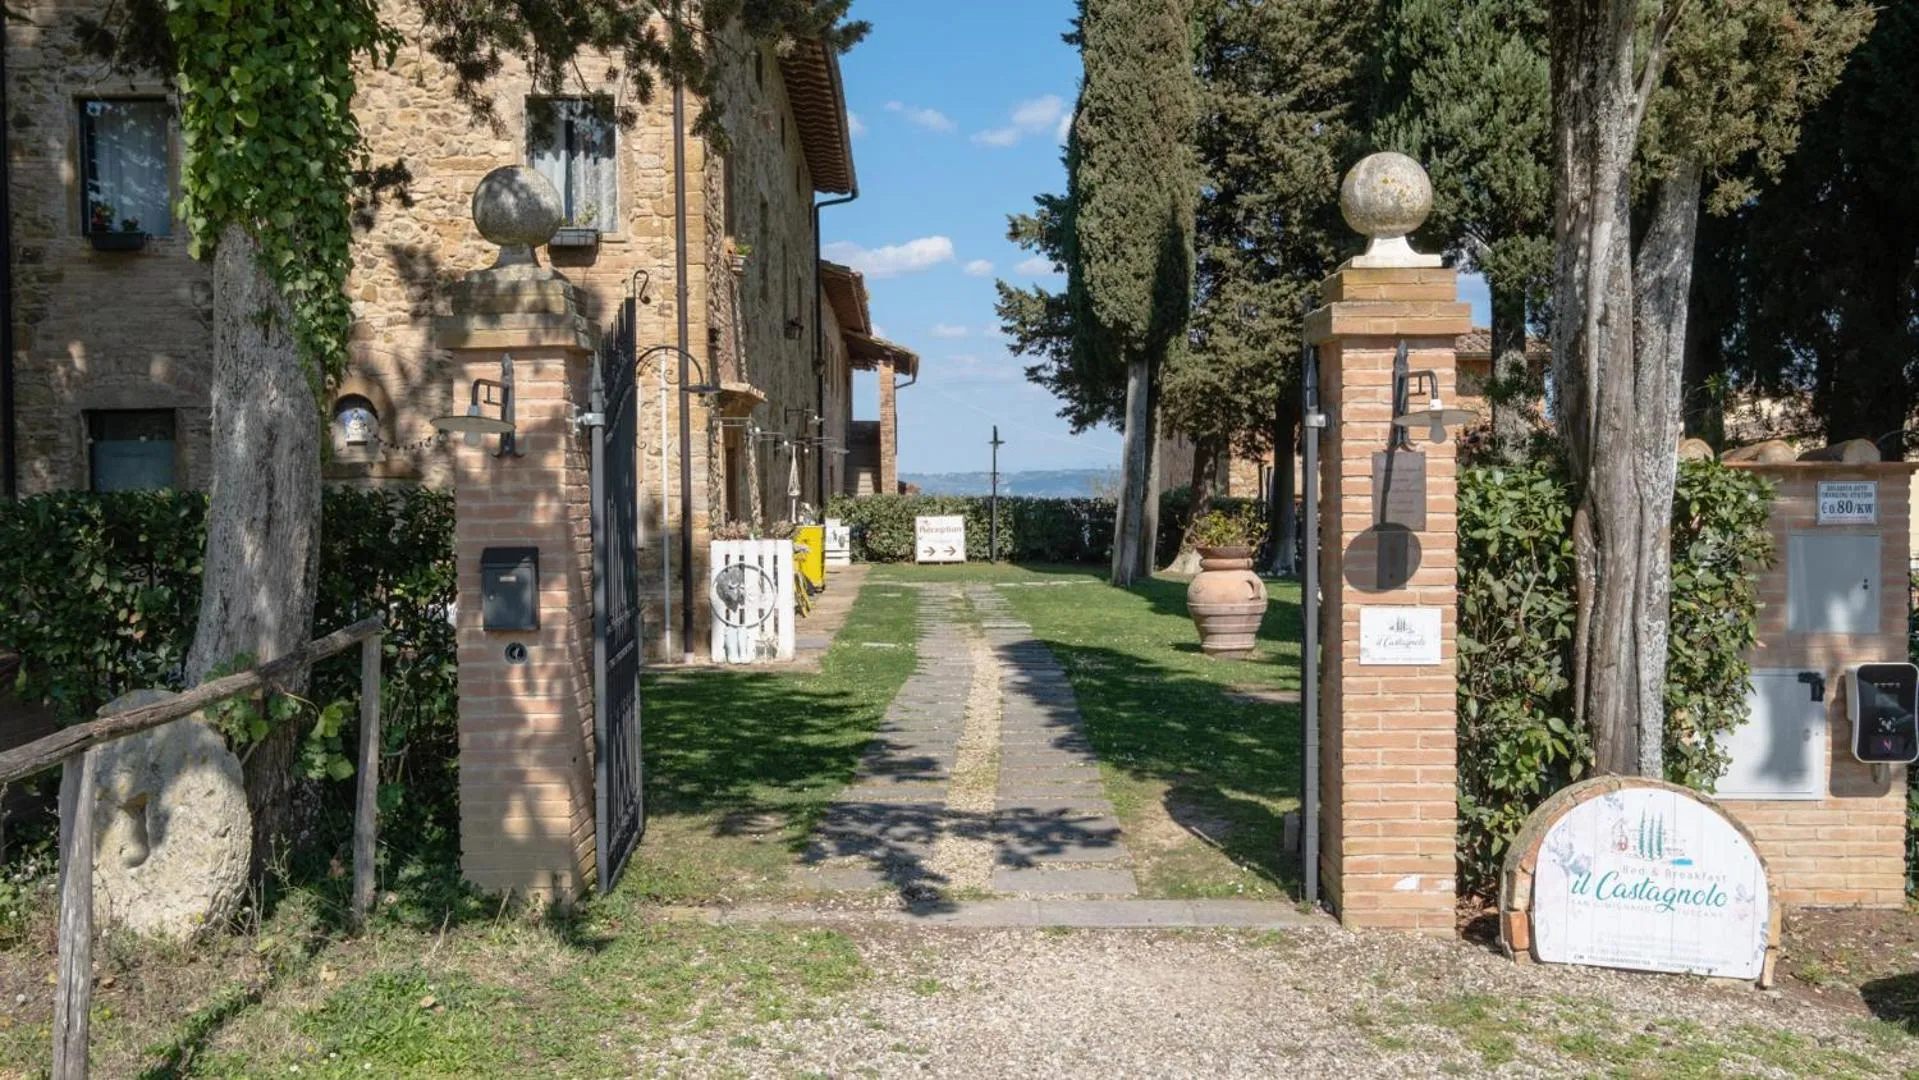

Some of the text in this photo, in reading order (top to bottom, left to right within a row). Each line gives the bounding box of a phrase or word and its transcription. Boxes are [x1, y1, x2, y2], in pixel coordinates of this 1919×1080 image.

[1622, 864, 1728, 883] Bed & Breakfast
[1571, 870, 1729, 914] il Castagnolo
